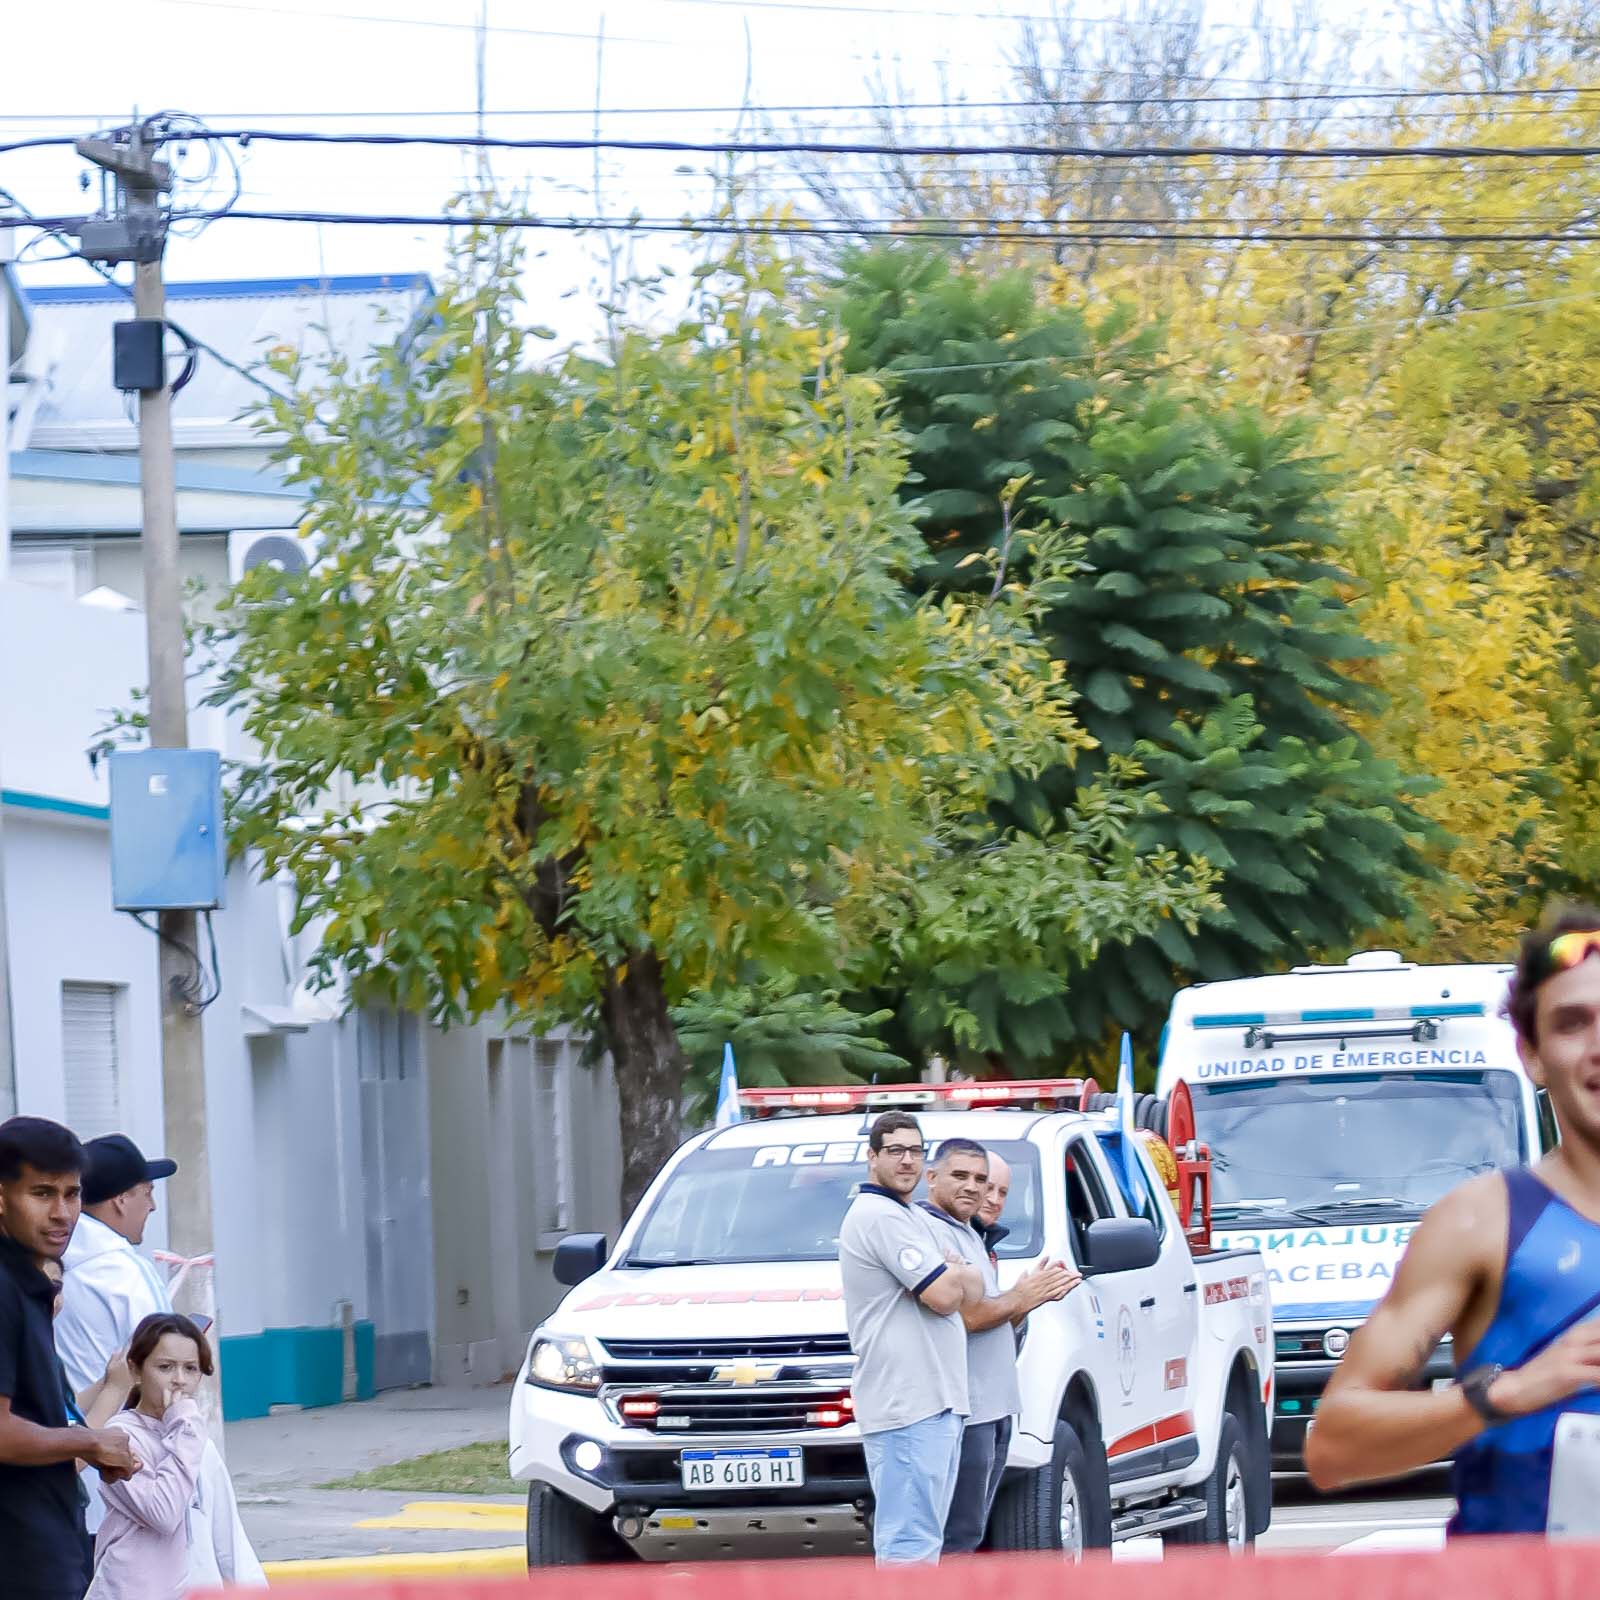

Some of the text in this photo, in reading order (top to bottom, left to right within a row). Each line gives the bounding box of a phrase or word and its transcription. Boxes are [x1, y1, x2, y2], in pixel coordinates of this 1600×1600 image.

[1198, 1049, 1487, 1078] UNIDAD DE EMERGENCIA
[690, 1461, 795, 1484] AB 608 HI
